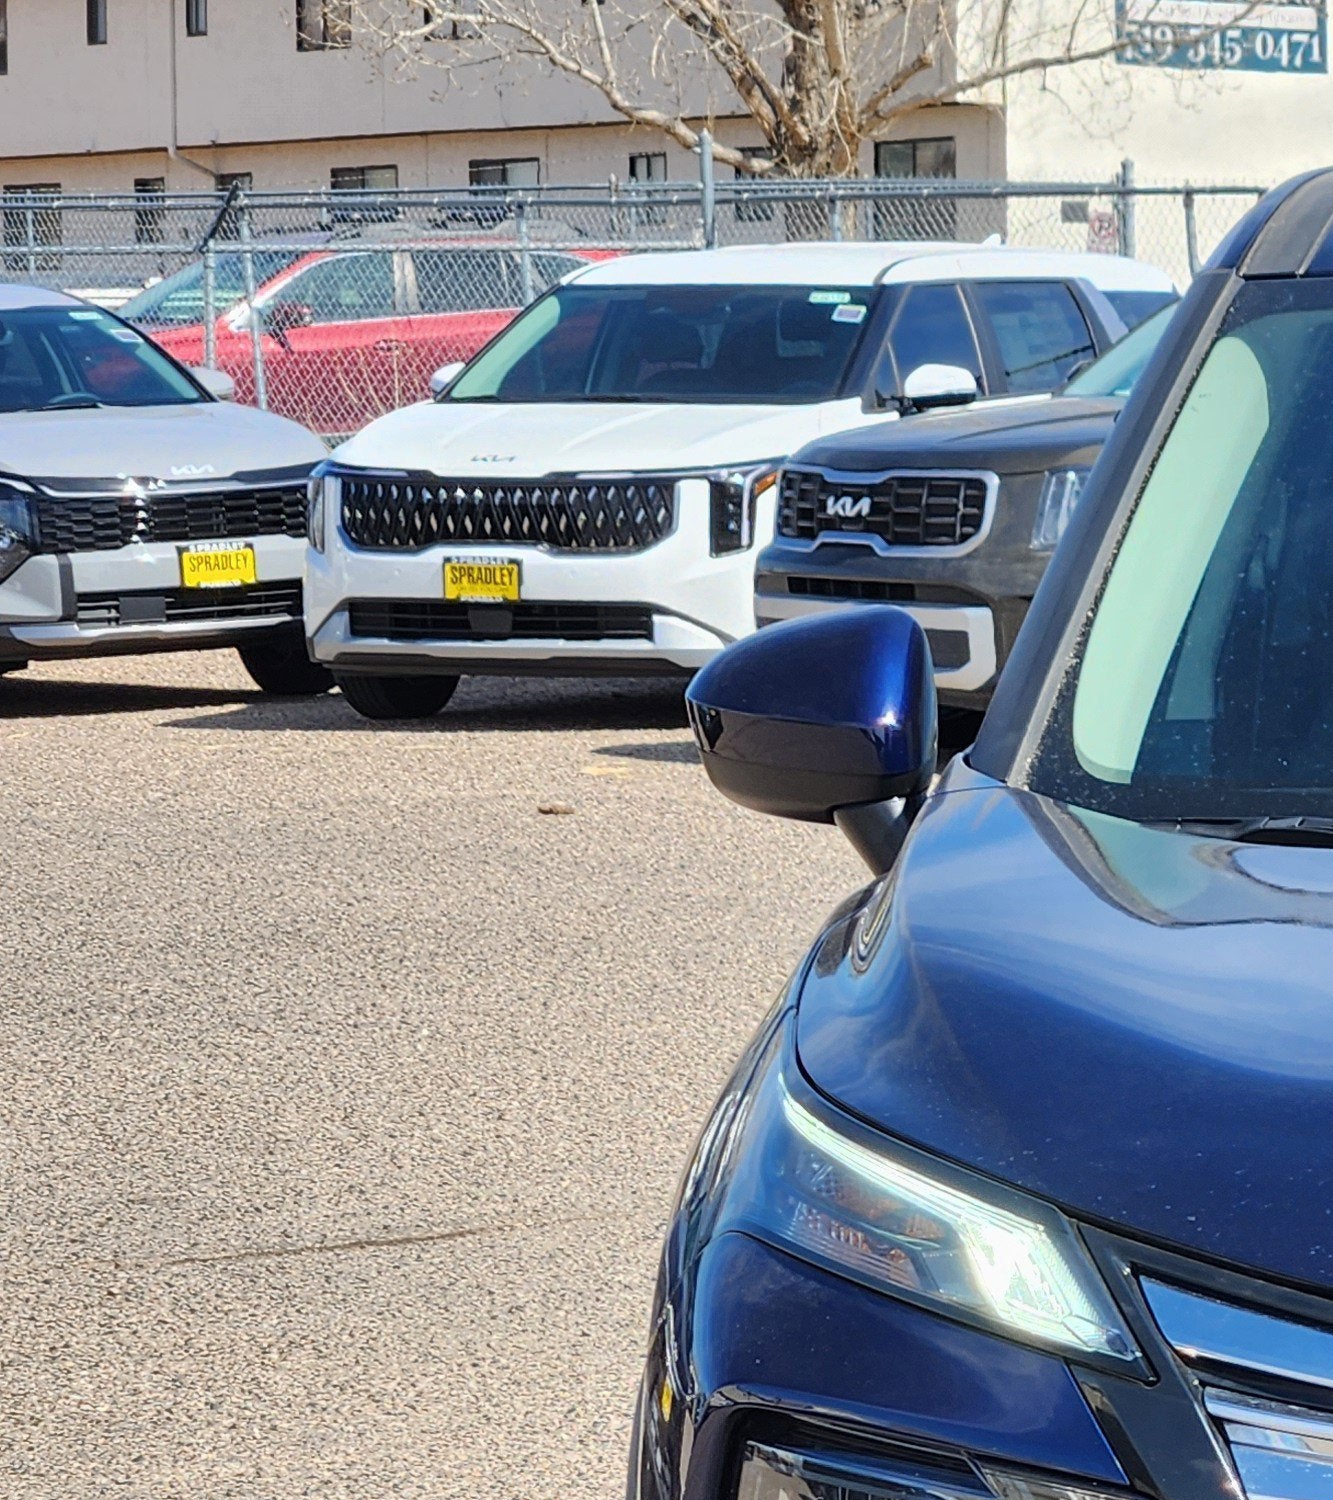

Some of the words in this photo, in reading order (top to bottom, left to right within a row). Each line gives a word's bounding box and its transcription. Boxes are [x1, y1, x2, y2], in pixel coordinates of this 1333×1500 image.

[826, 495, 871, 517] KIA
[189, 553, 248, 573] SPRADLEY
[450, 566, 514, 586] SPRADLEY
